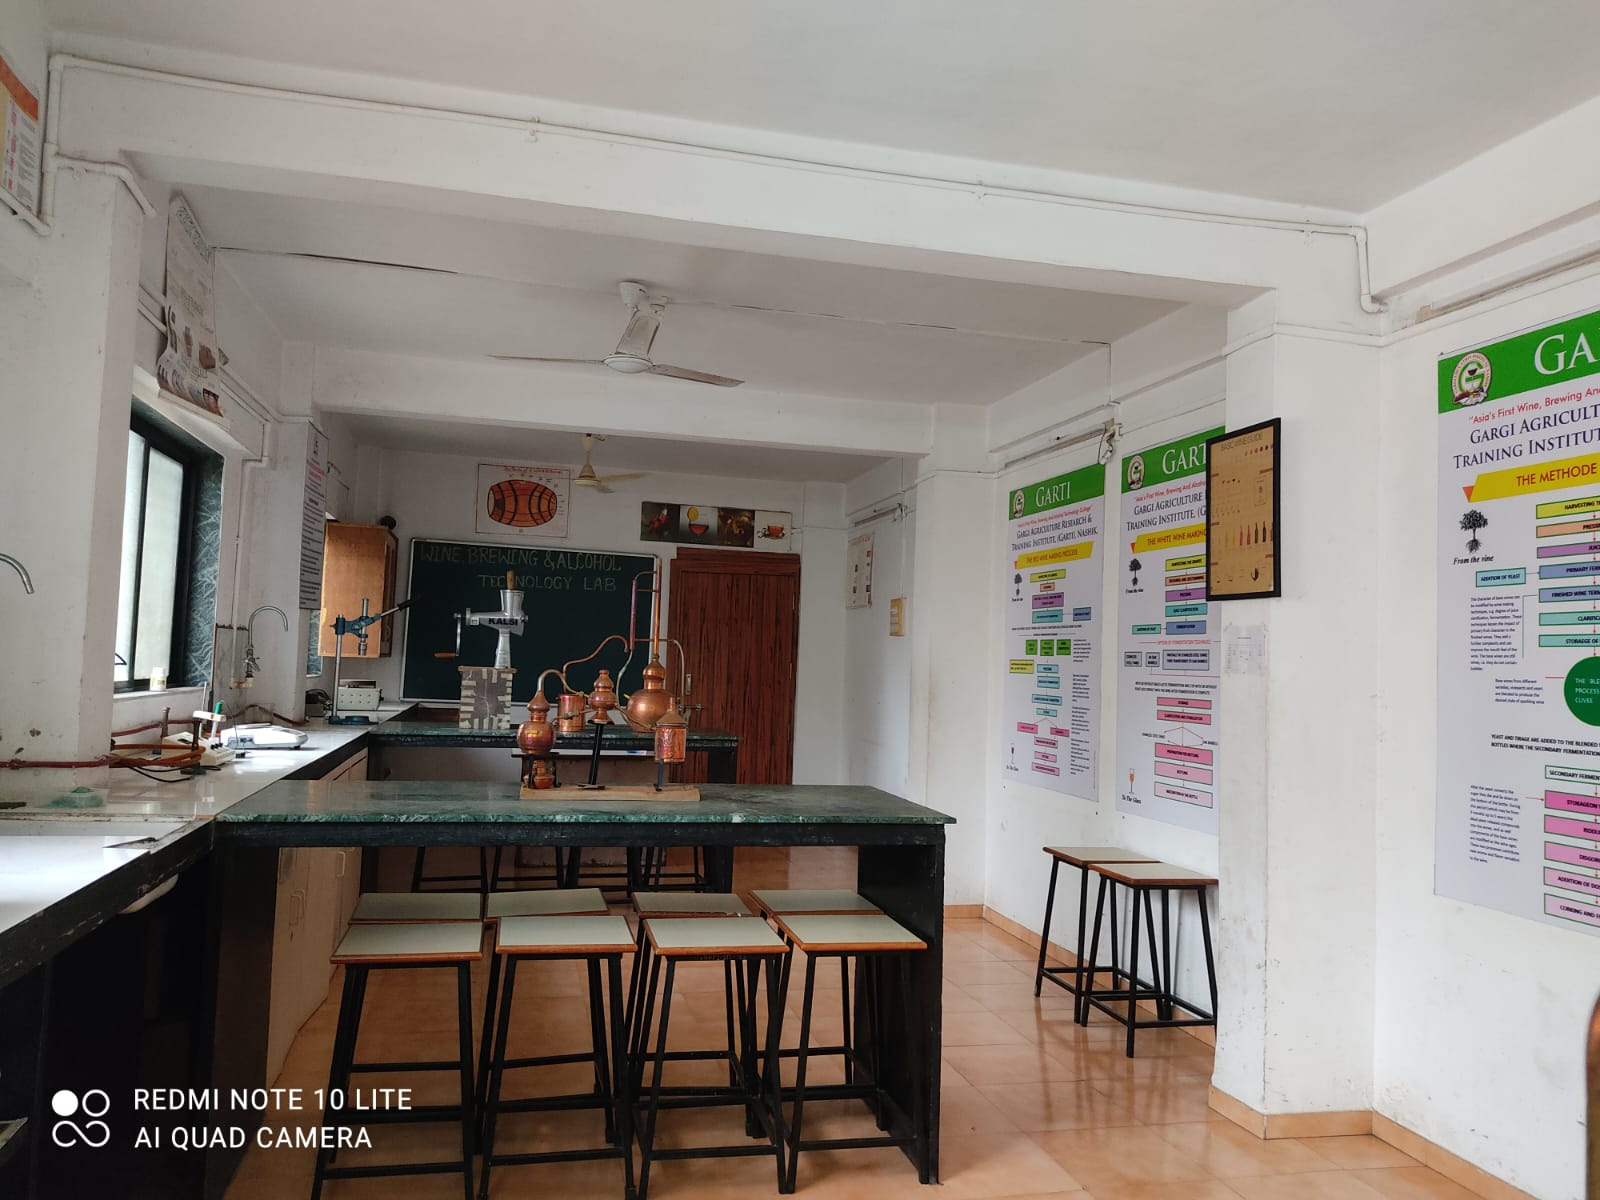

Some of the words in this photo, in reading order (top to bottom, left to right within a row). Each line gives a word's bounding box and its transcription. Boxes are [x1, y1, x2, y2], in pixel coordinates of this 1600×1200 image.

[1534, 331, 1600, 375] GA
[1498, 407, 1515, 418] First
[1517, 402, 1542, 413] Wine,
[1544, 392, 1582, 407] Brewing
[1470, 423, 1515, 444] GARGI
[1520, 403, 1600, 434] AGRICULT
[1454, 444, 1523, 469] TRAINING
[1516, 474, 1536, 486] THE
[1540, 463, 1597, 483] METHODE
[1036, 481, 1070, 507] GARTI
[1134, 504, 1153, 515] GARGI
[1155, 492, 1203, 511] AGRICULTURE
[1127, 515, 1157, 531] TRAINING
[466, 546, 539, 566] BREWING
[543, 551, 557, 570] &
[556, 551, 622, 572] ALCOHOL
[1453, 557, 1469, 565] From
[478, 574, 573, 591] TECNOLOGY
[583, 577, 616, 592] LAB
[488, 617, 519, 626] KALSI
